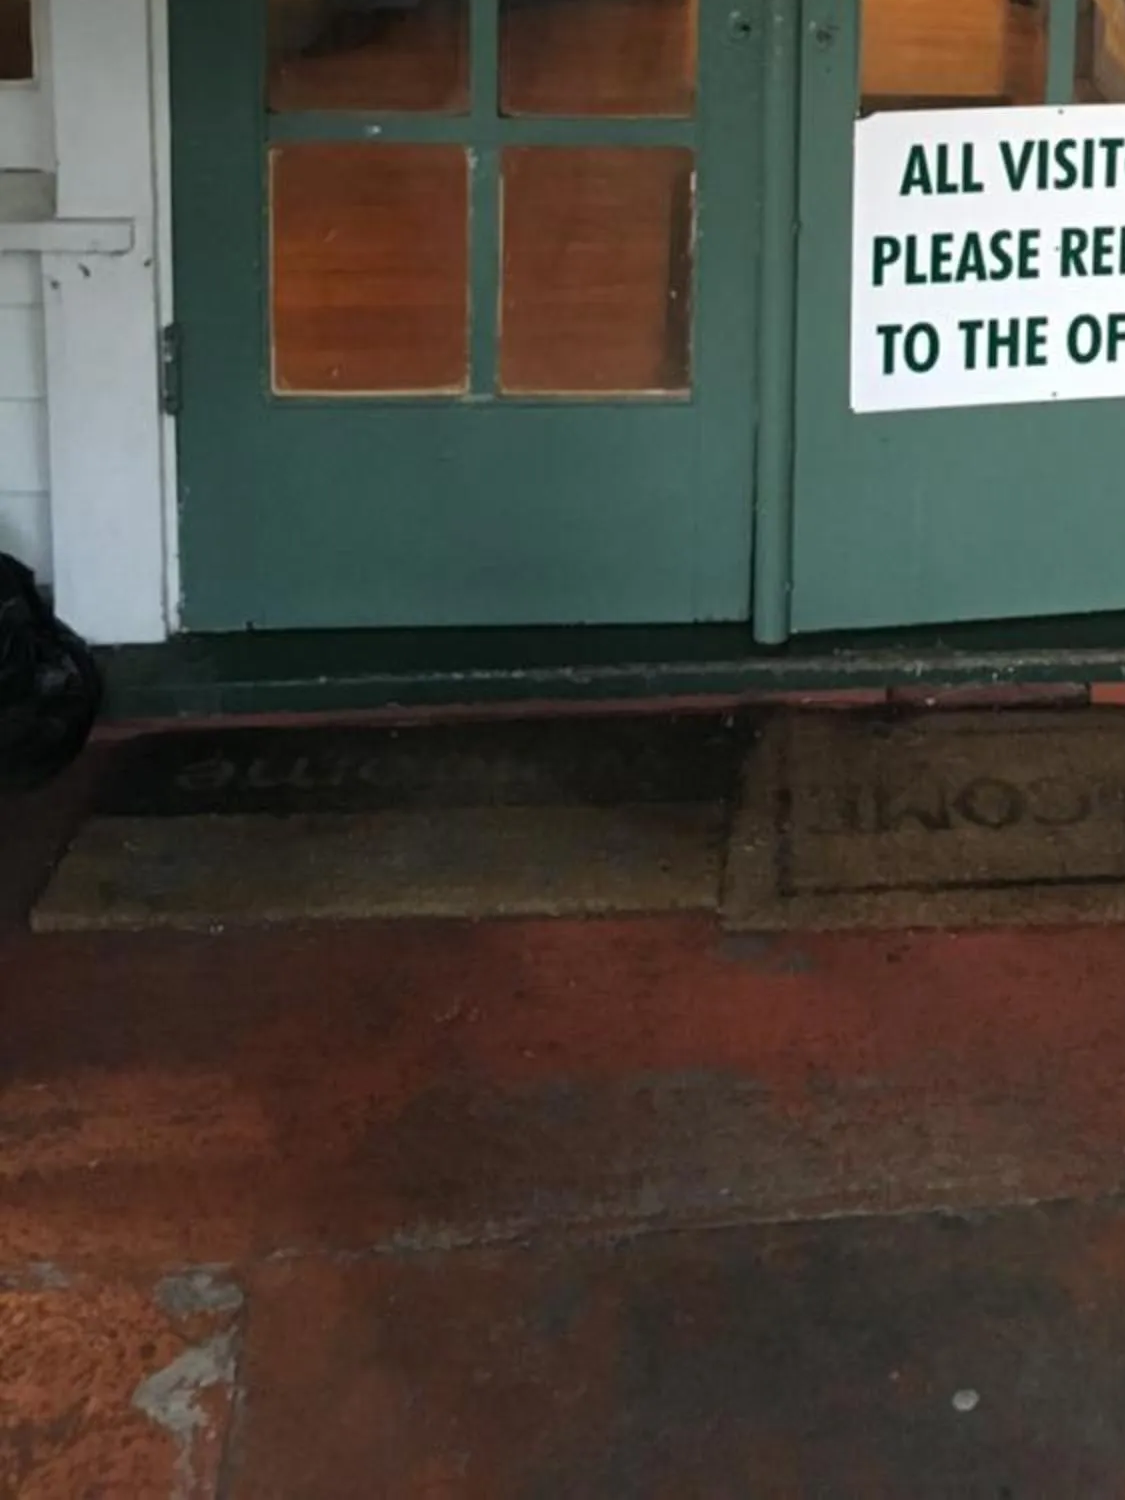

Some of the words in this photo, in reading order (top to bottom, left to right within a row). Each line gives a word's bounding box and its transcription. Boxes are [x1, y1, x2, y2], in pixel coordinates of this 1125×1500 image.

[900, 143, 984, 196] ALL
[872, 229, 1041, 287] PLEASE
[877, 322, 940, 375] TO
[958, 316, 1048, 370] THE
